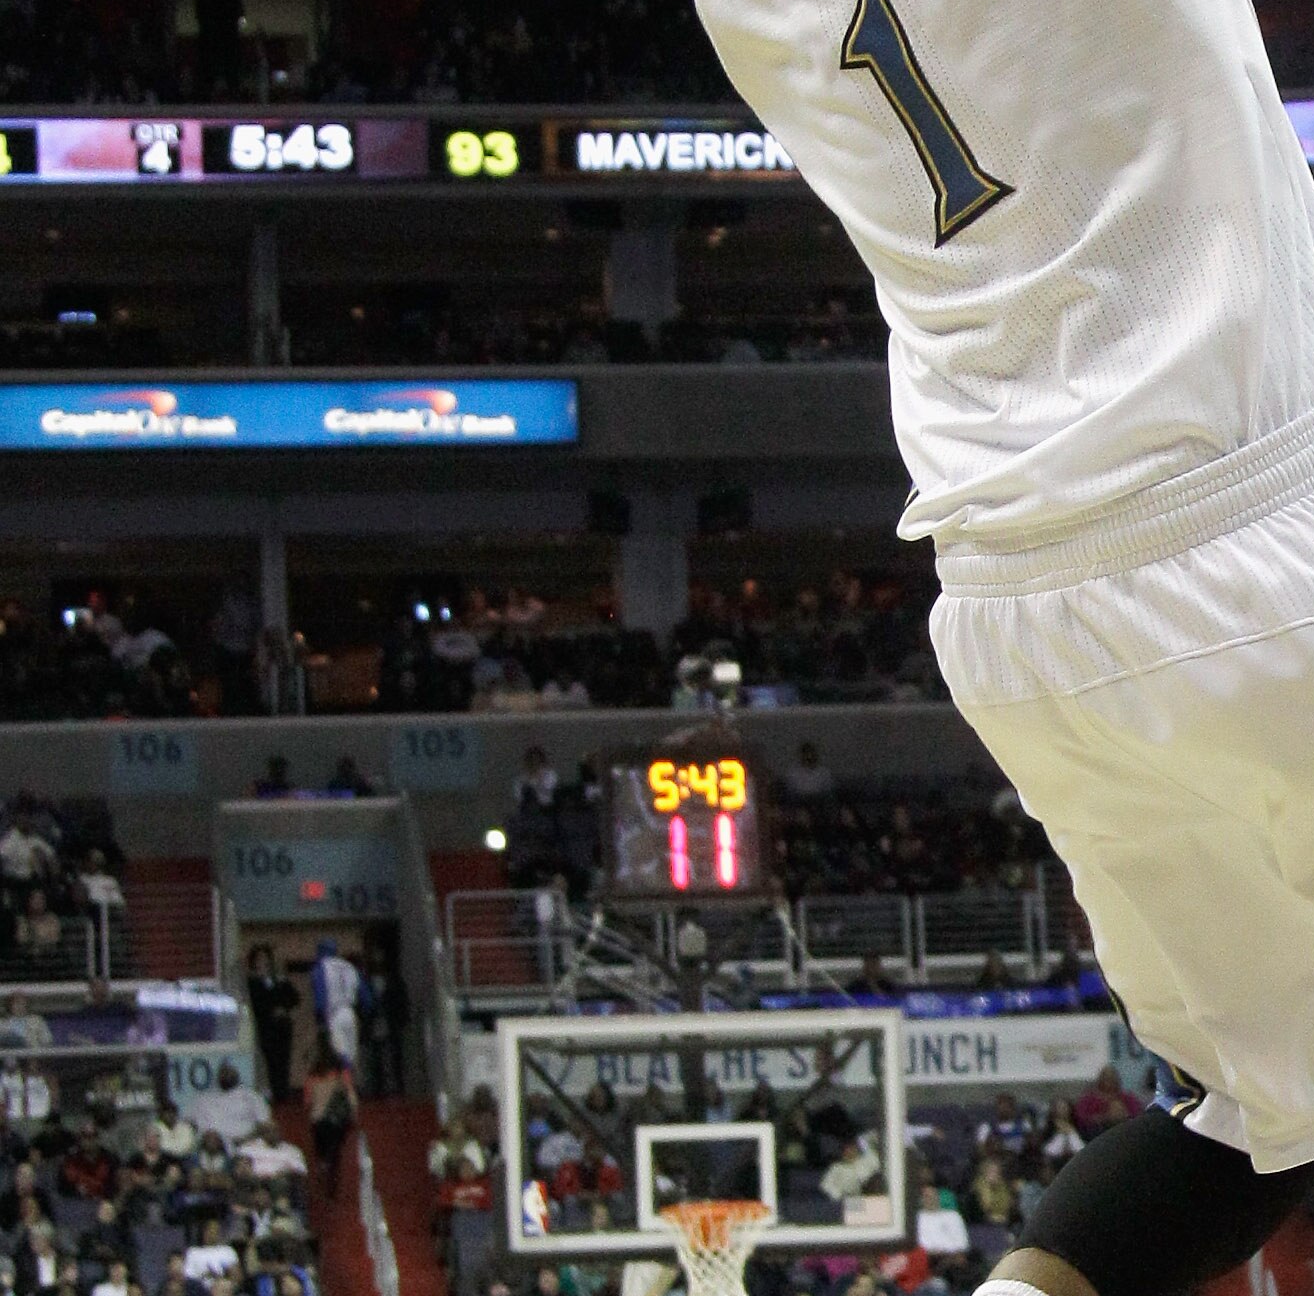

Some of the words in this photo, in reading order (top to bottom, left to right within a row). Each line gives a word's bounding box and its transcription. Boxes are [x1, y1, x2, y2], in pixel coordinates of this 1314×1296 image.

[135, 122, 180, 145] QTR
[230, 123, 353, 171] 5:43
[141, 139, 172, 174] 4
[446, 130, 518, 177] 93
[121, 734, 182, 766] 106
[405, 729, 466, 760] 105
[648, 758, 747, 813] 5:43
[234, 846, 295, 878] 106
[667, 812, 737, 891] 11
